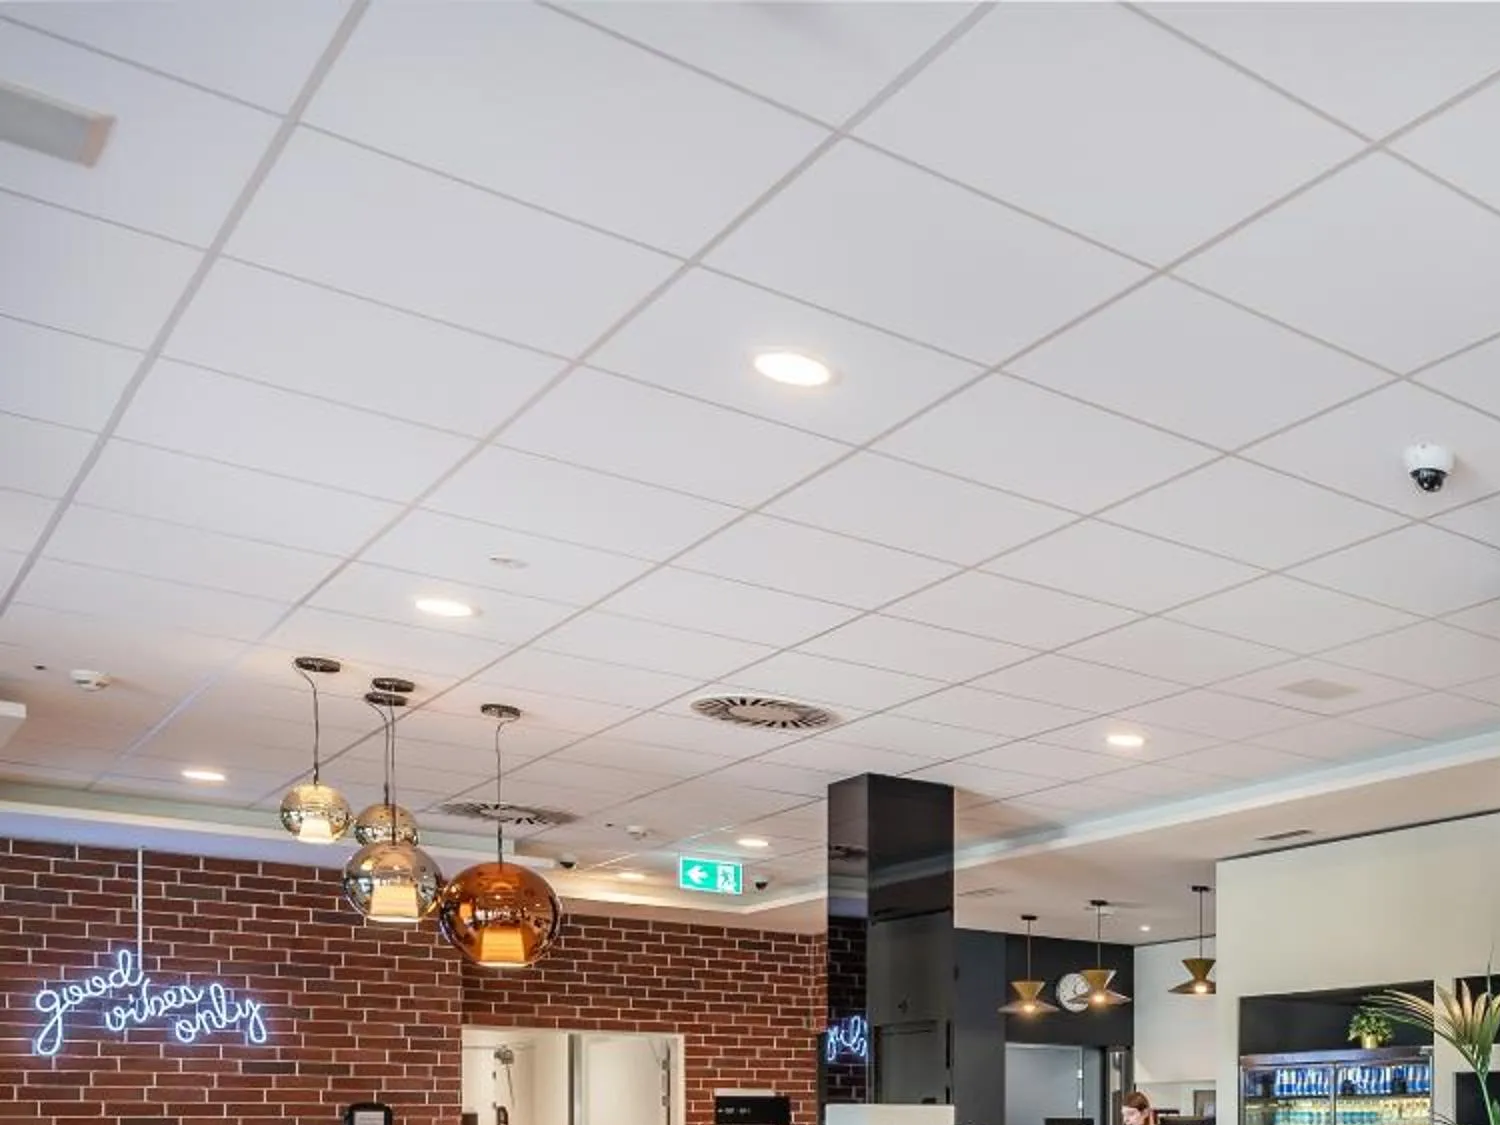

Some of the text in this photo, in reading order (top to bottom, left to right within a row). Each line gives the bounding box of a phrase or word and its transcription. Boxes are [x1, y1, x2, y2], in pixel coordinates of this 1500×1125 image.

[35, 949, 145, 1055] good
[105, 977, 205, 1031] vibes
[175, 983, 268, 1043] only
